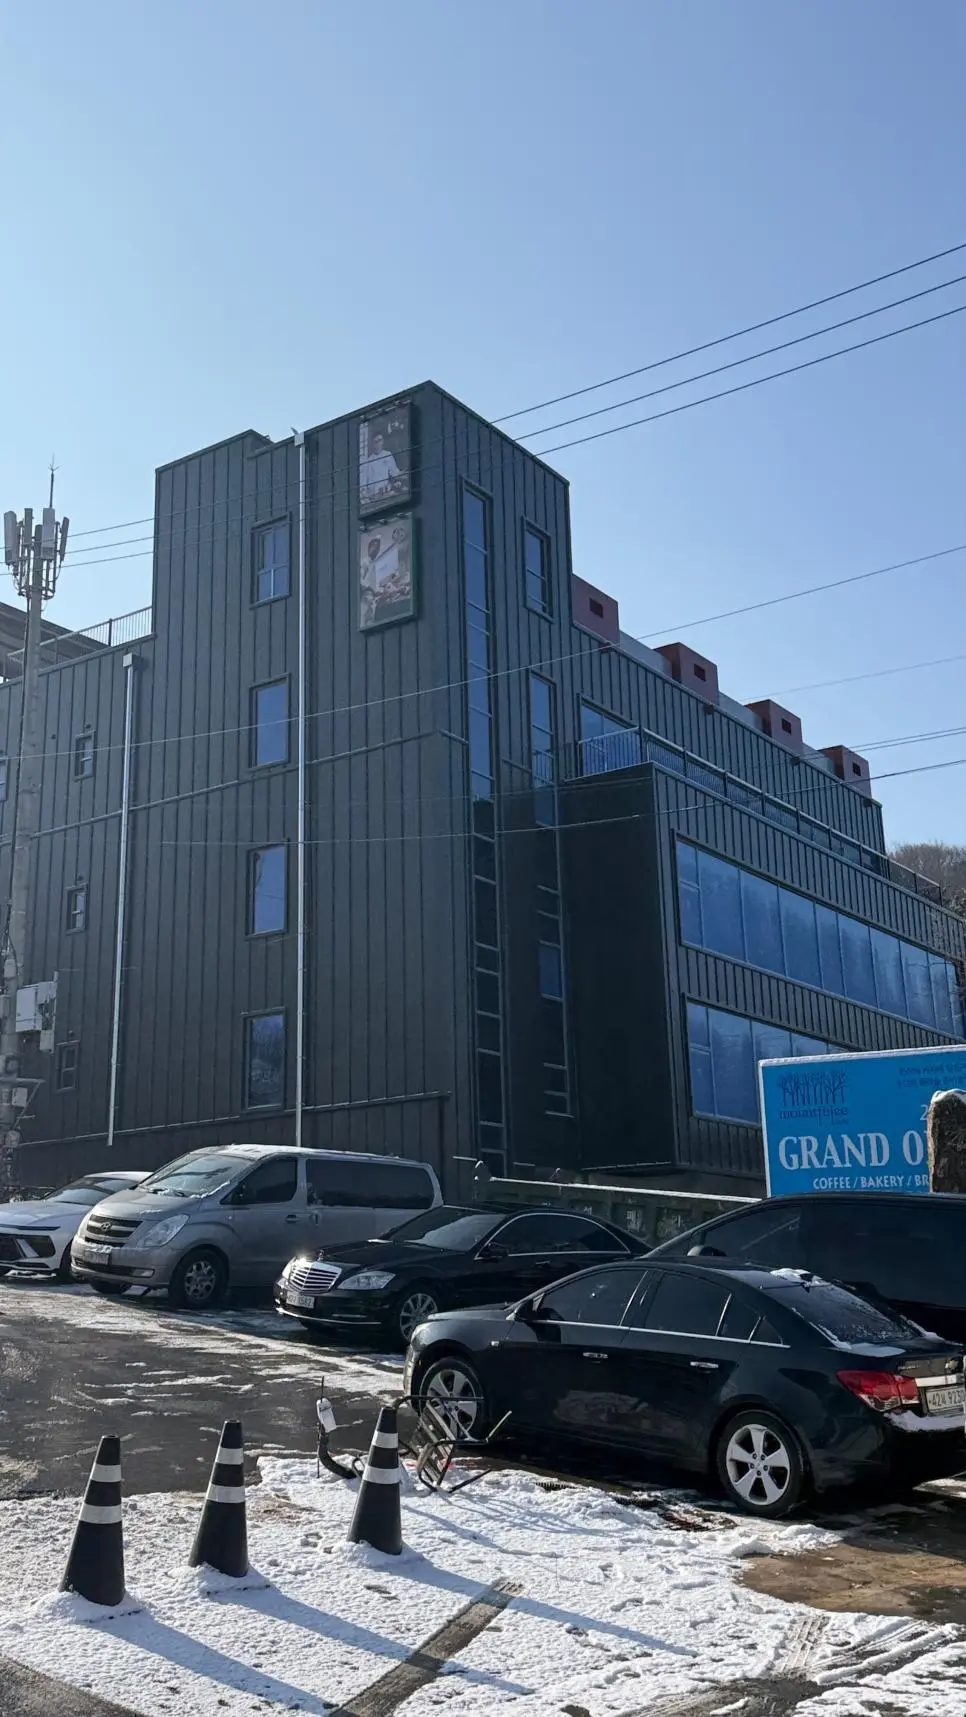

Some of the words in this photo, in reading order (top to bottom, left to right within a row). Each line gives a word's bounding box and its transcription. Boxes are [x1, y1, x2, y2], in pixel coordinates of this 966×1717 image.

[920, 1104, 929, 1121] 2
[778, 1132, 890, 1171] GRAND
[902, 1130, 930, 1167] O
[813, 1176, 851, 1190] COFFEE
[860, 1175, 904, 1188] BAKERY
[915, 1174, 930, 1187] BR
